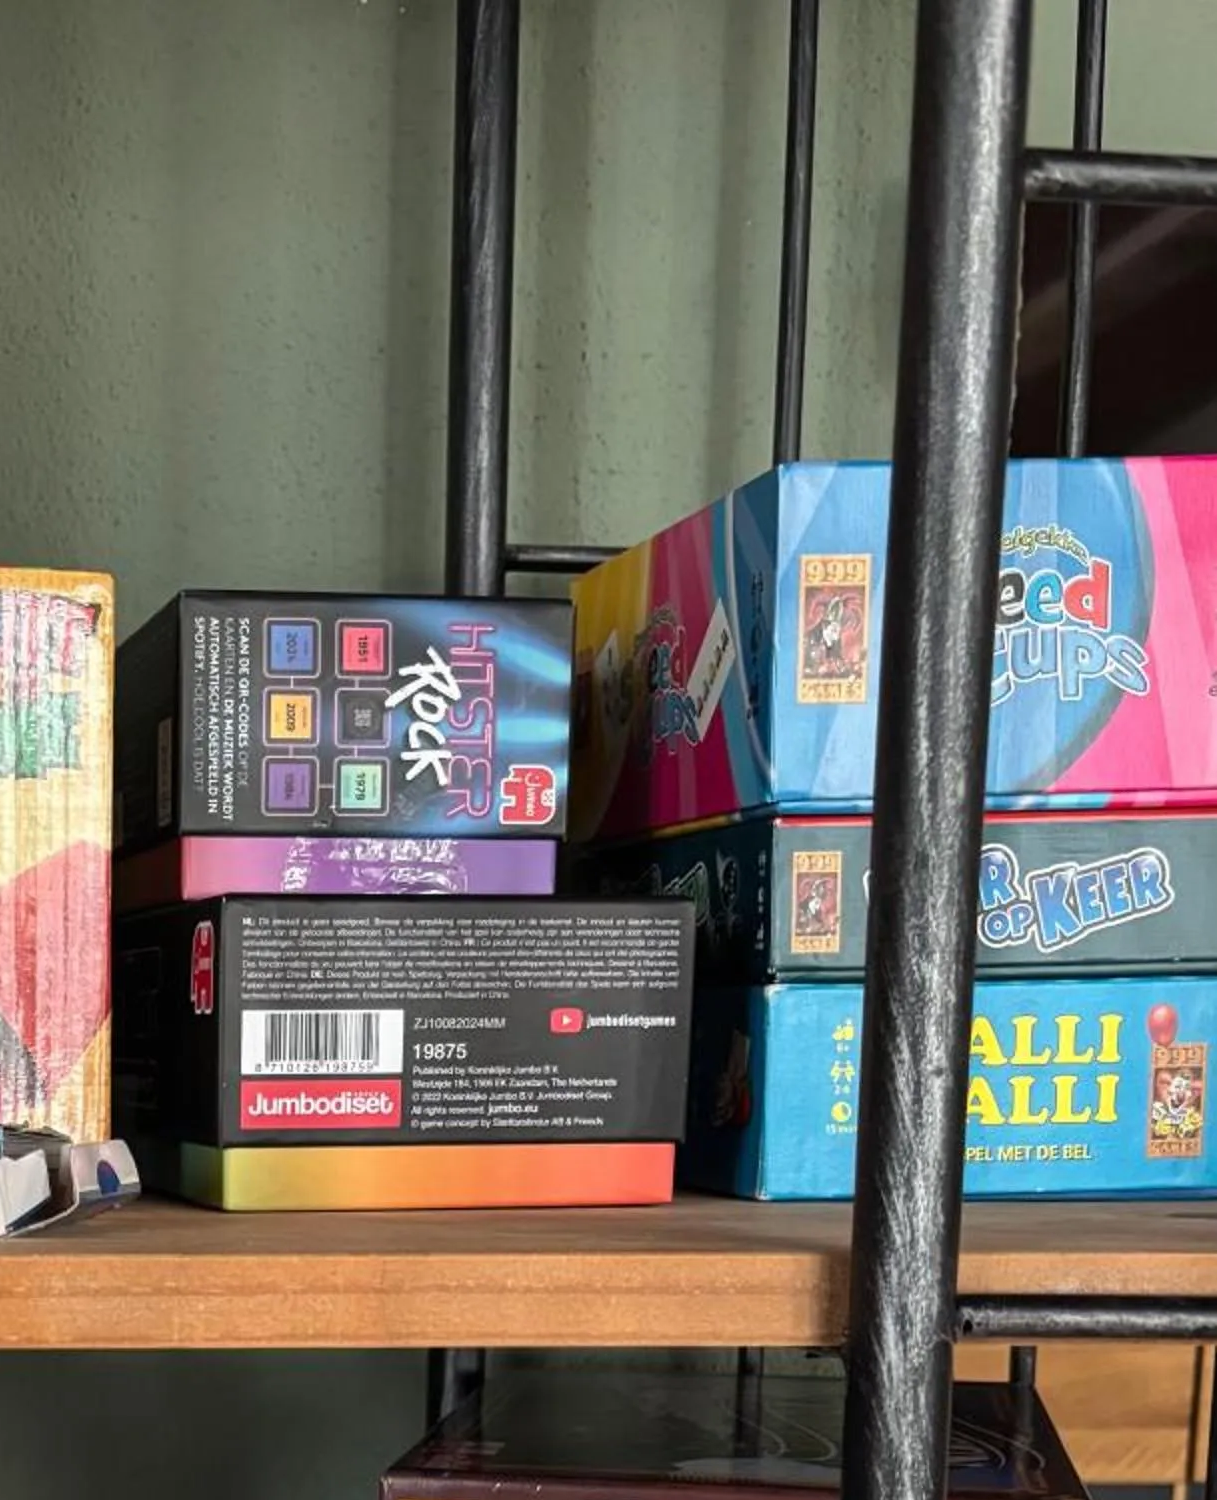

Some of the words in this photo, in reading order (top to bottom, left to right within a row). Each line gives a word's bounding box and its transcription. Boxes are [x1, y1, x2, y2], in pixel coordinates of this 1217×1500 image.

[807, 560, 865, 582] 999
[996, 568, 1111, 631] eed
[238, 617, 250, 655] SCAN
[385, 646, 461, 786] ROCK
[447, 624, 496, 818] HITSTER
[1030, 851, 1172, 948] KEER
[586, 1014, 676, 1029] jumbodisetgames
[969, 1014, 1124, 1065] ALLI
[413, 1043, 467, 1060] 19875
[248, 1091, 394, 1115] Jumbodiset
[966, 1074, 1120, 1125] ALLI
[998, 1146, 1033, 1162] MET
[1036, 1145, 1059, 1161] DE
[1063, 1144, 1092, 1160] BEL
